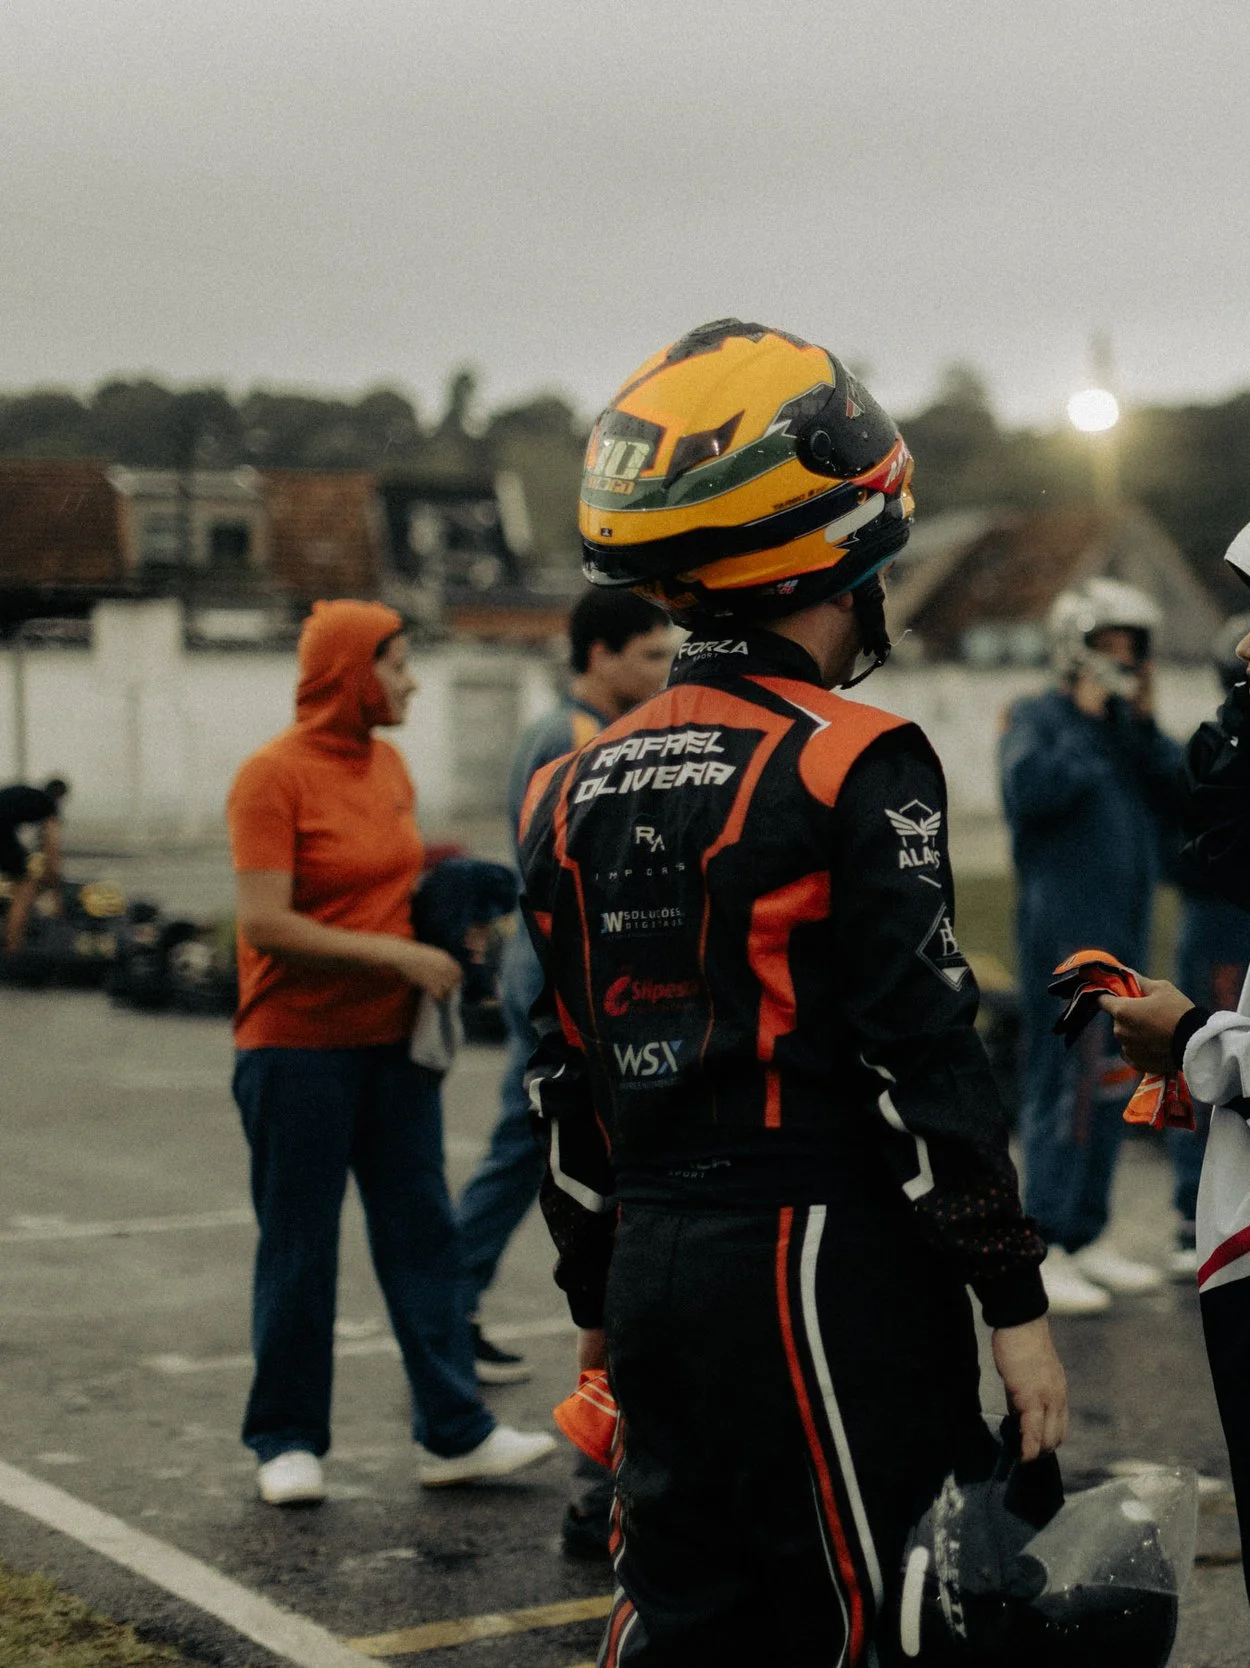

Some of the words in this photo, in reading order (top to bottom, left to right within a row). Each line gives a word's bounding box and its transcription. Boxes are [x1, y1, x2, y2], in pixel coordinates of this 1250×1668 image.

[679, 639, 749, 660] FORZA
[592, 730, 725, 771] RAFAEL
[574, 761, 737, 804] OLIVERA
[613, 1040, 684, 1077] WSX
